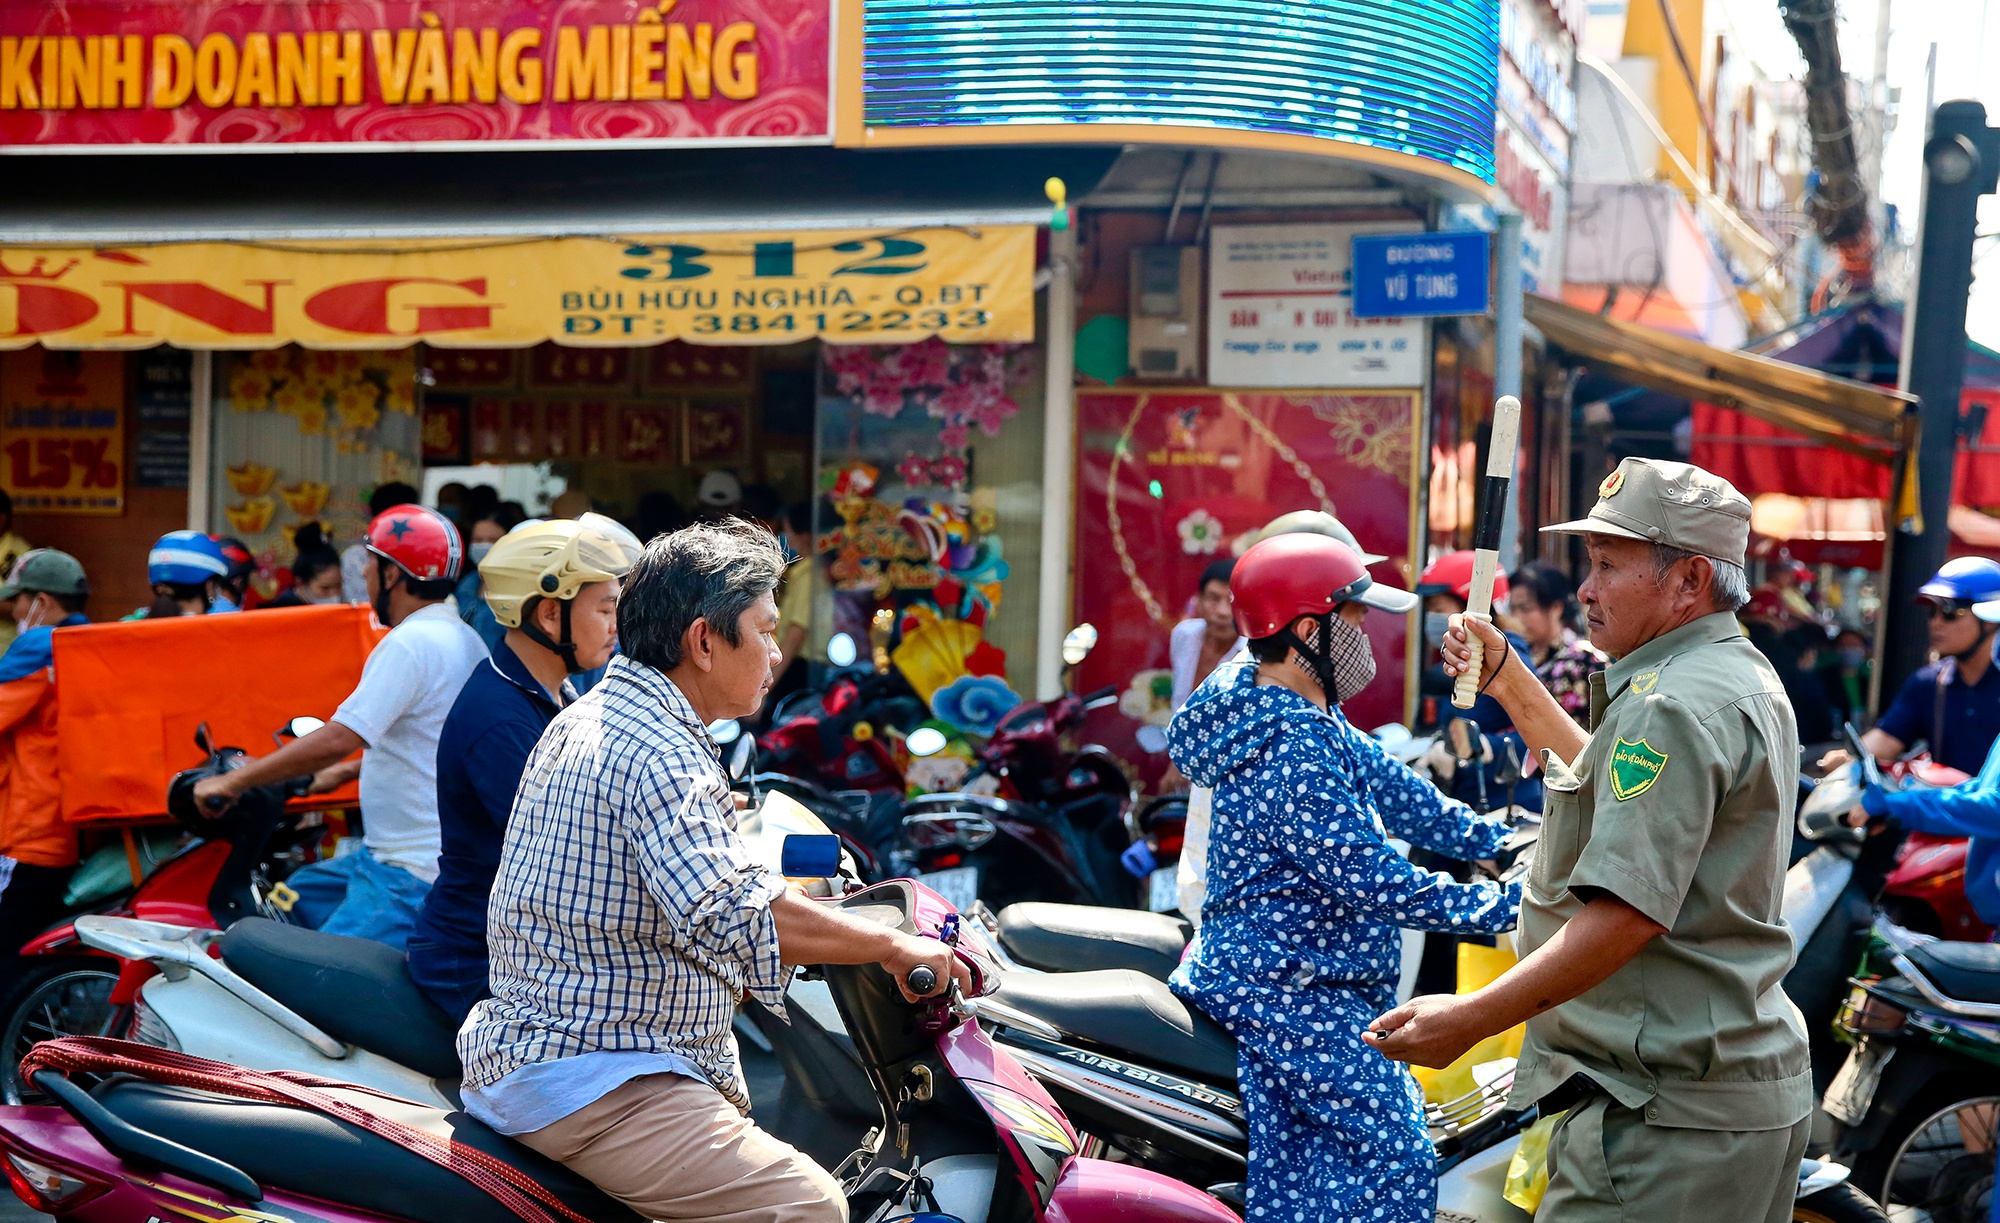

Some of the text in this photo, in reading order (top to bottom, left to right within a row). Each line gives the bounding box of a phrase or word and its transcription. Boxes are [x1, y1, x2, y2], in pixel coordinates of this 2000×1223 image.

[0, 0, 757, 109] KINH DOANH VÀNG MIẾNG
[620, 237, 927, 283] 312
[562, 285, 624, 311] BÙI
[641, 284, 717, 310] HỮU
[733, 282, 854, 308] NGHĨA
[895, 284, 989, 306] Q.BT
[563, 308, 989, 335] ĐT: 38412233
[1615, 749, 1627, 761] BẢO
[1634, 755, 1647, 768] DÂN
[1646, 761, 1661, 773] PHỐ
[1057, 1051, 1240, 1113] AIR BLADE
